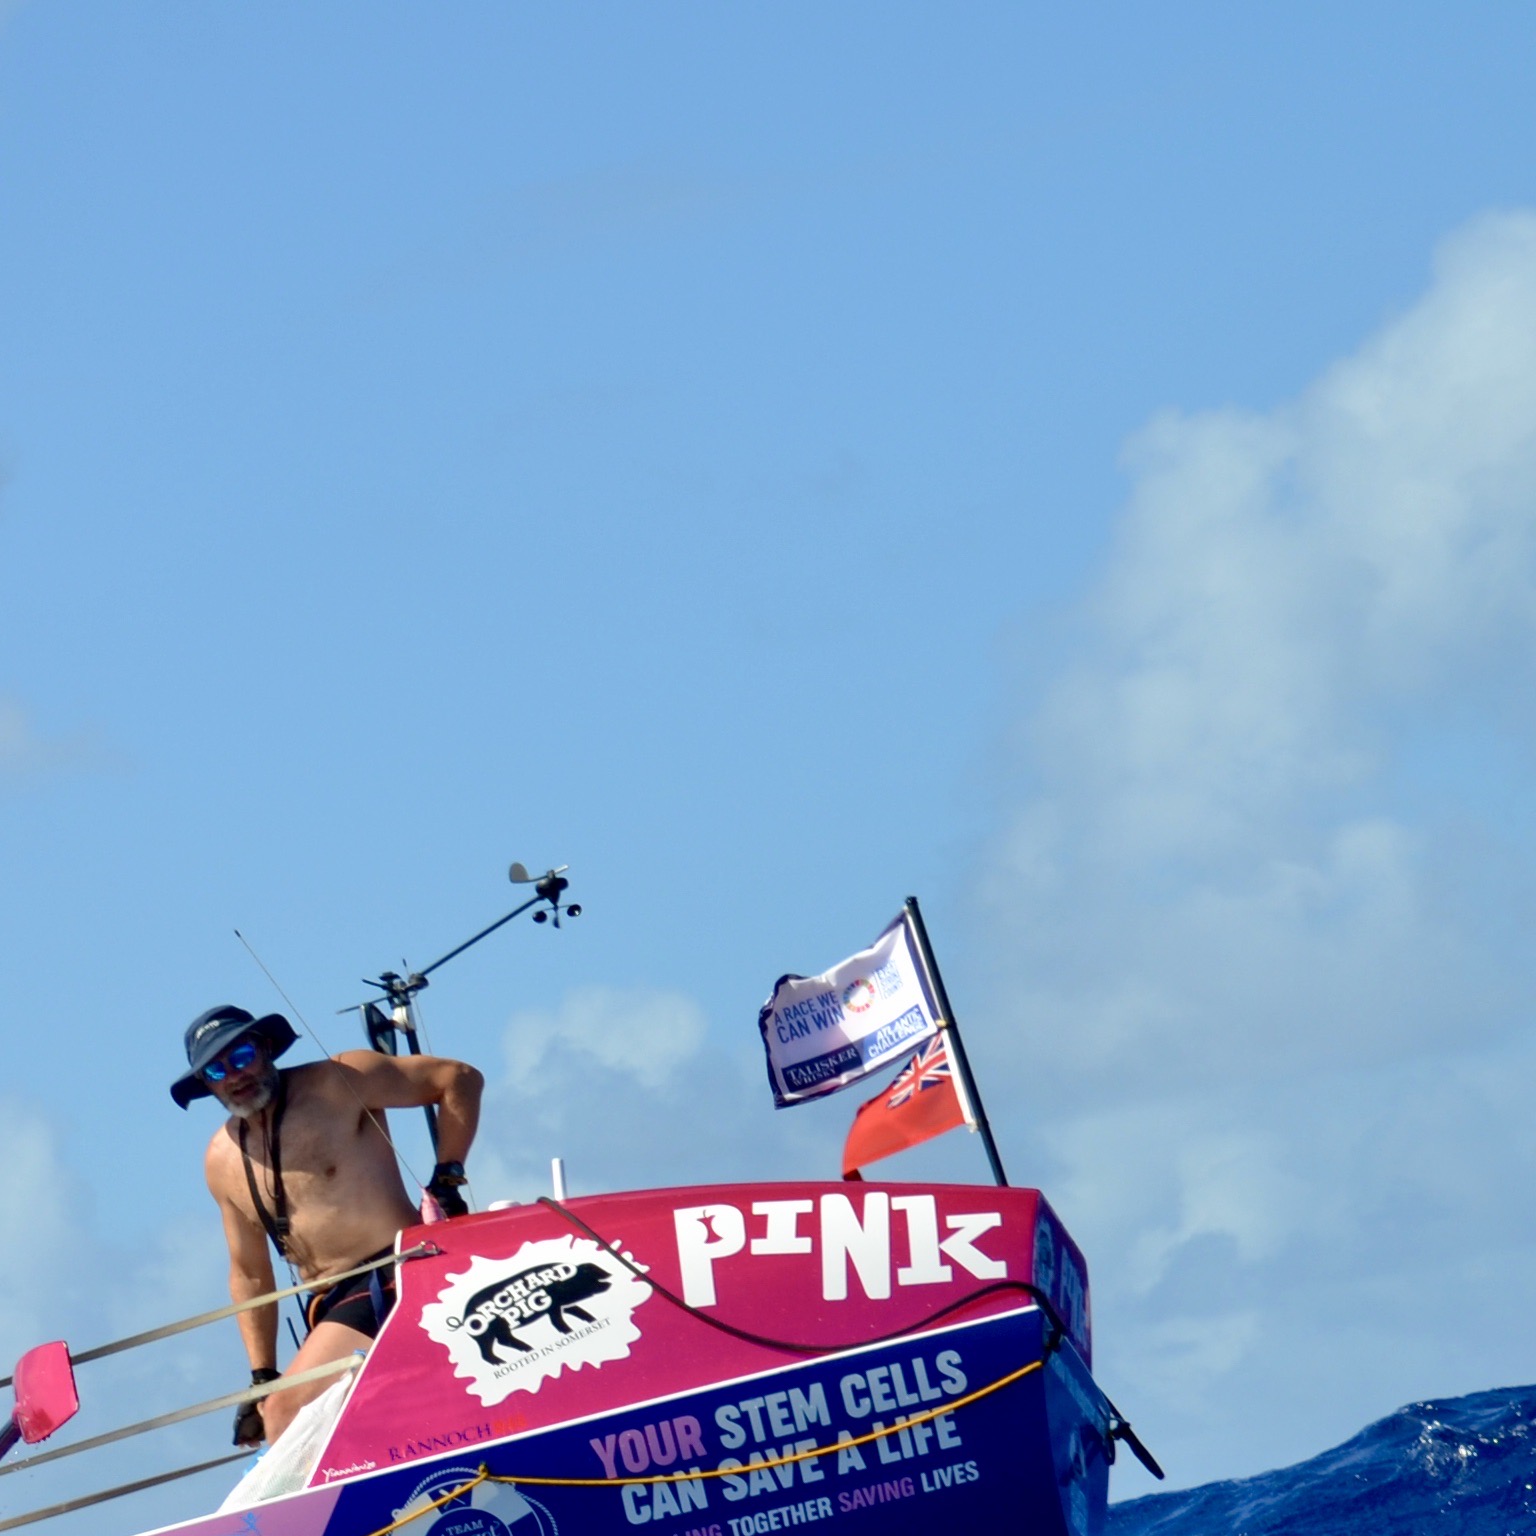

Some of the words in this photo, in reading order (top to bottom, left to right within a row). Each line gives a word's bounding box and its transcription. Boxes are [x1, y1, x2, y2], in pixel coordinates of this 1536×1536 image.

[777, 1014, 811, 1044] CAN
[814, 1004, 846, 1030] WIN
[783, 996, 817, 1021] RACE
[817, 989, 839, 1009] WE
[787, 1047, 857, 1080] TALISKER
[792, 1067, 836, 1087] WHISKY
[462, 1262, 577, 1337] ORCHARD
[500, 1288, 553, 1330] PIG
[493, 1351, 540, 1380] ROOTED
[541, 1344, 554, 1357] IN
[554, 1317, 612, 1350] SOMERSET
[590, 1415, 708, 1479] YOUR
[714, 1381, 830, 1450] STEM
[839, 1350, 968, 1419] CELLS
[388, 1422, 491, 1461] RANNOCH
[620, 1466, 709, 1525] CAN
[721, 1437, 824, 1502] SAVE
[836, 1437, 867, 1476] A
[875, 1408, 962, 1465] LIFE
[837, 1477, 915, 1513] SAVING
[921, 1460, 980, 1493] LIVES
[445, 1519, 484, 1536] TEAM
